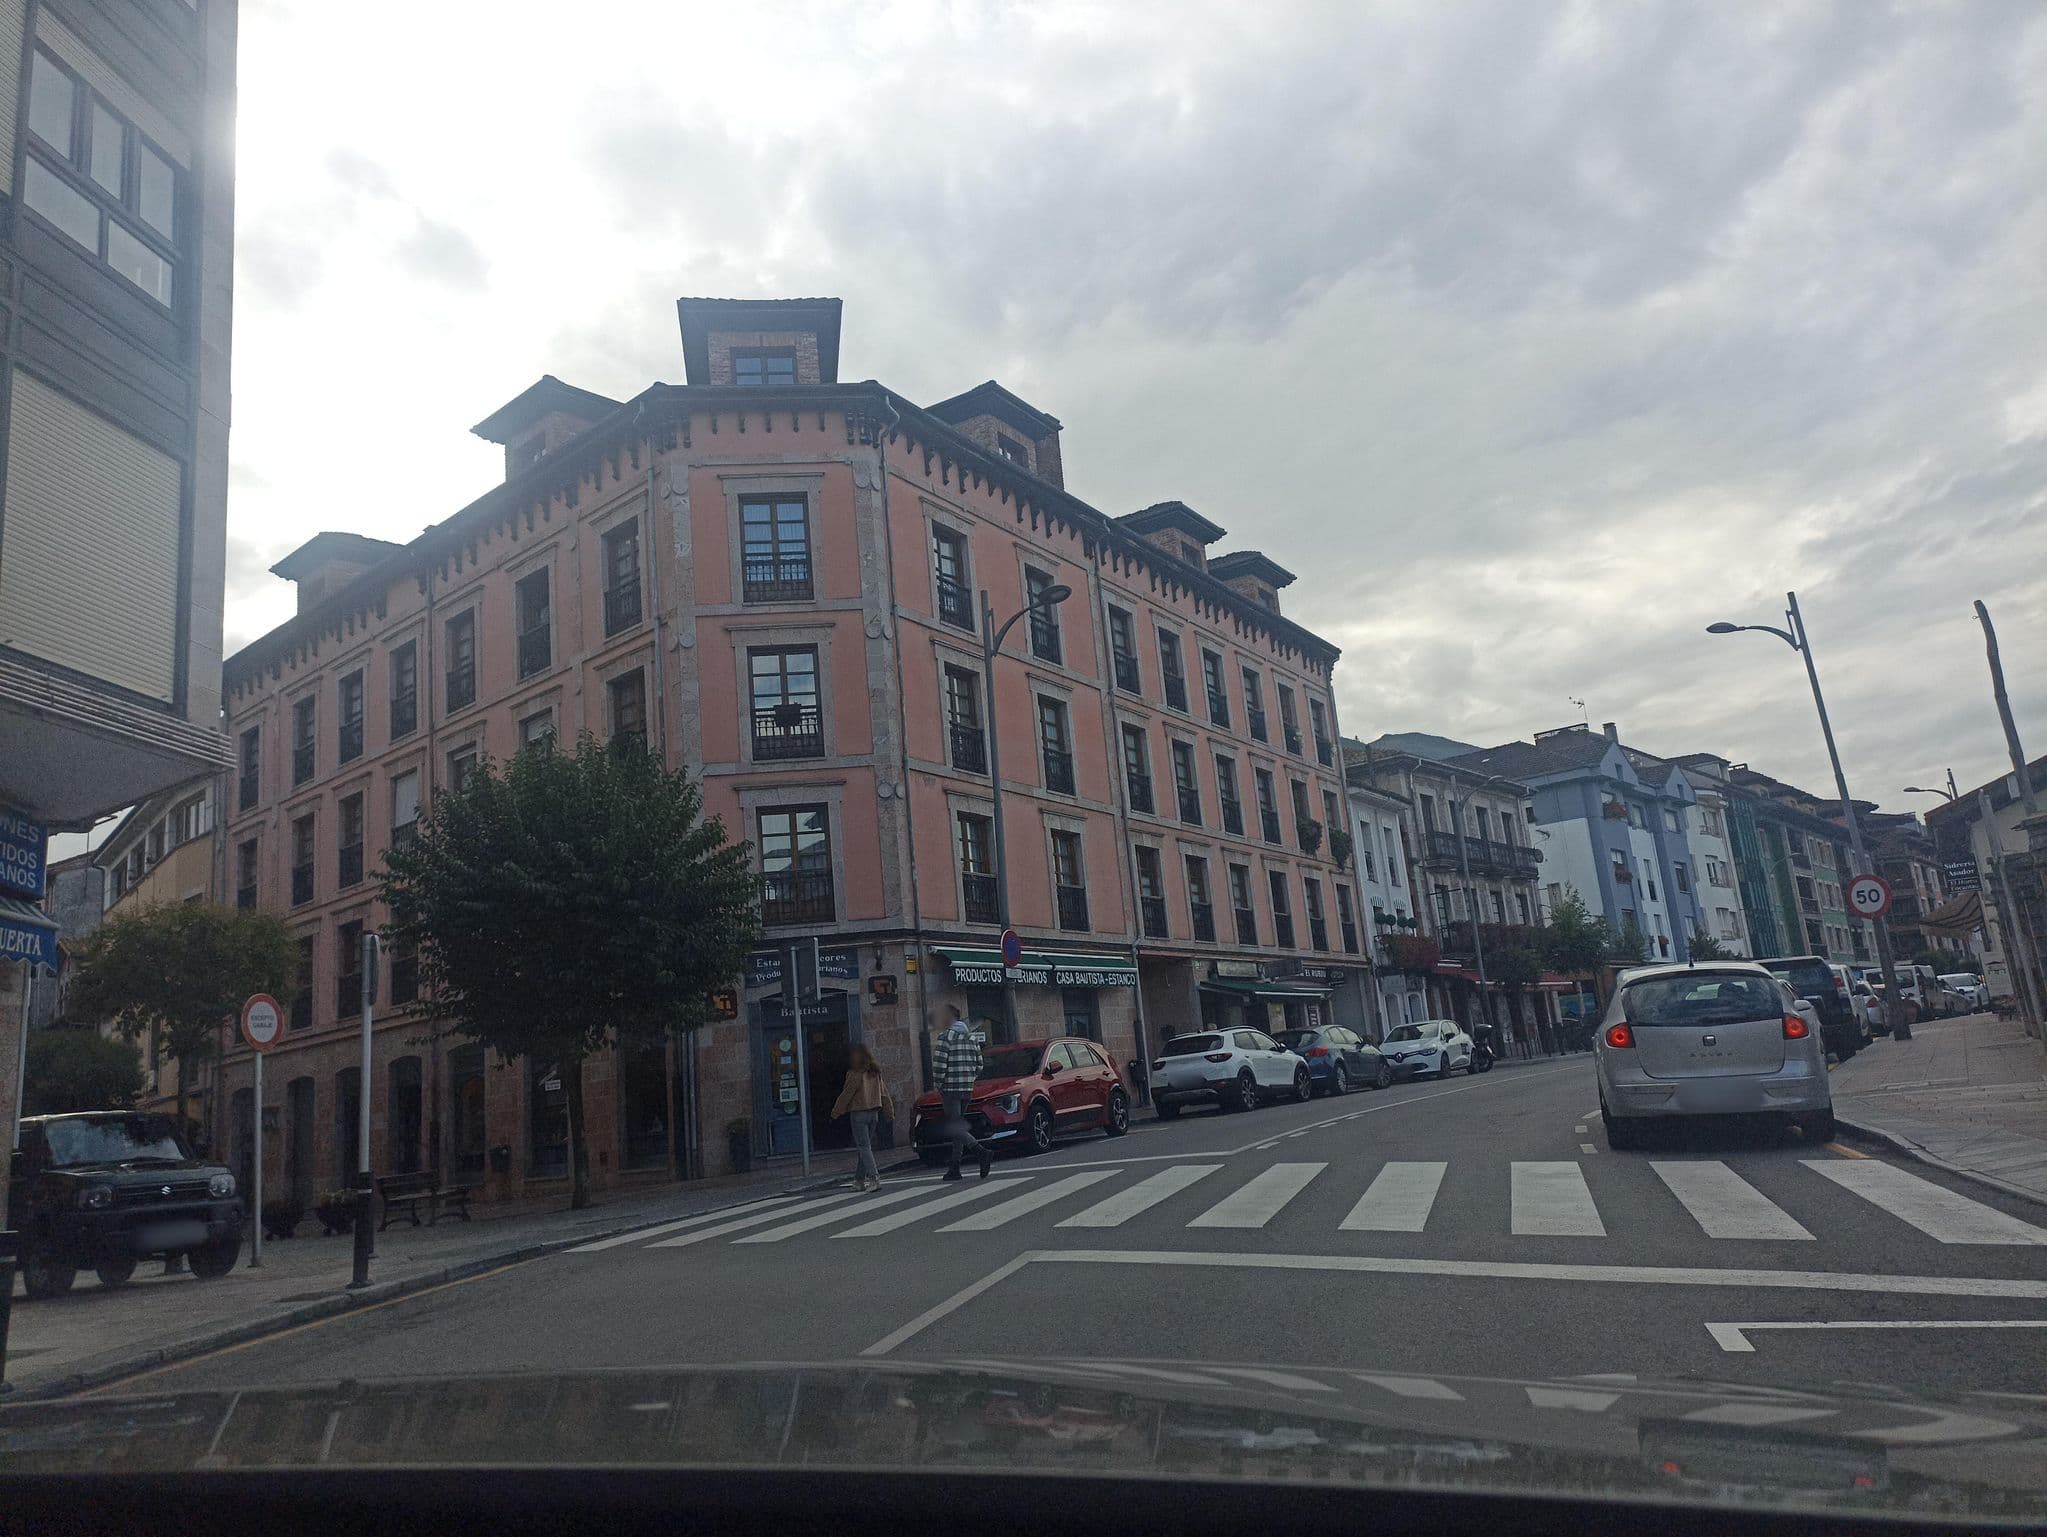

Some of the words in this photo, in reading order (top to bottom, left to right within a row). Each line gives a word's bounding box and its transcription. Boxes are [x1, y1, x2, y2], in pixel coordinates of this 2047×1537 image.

[0, 842, 37, 869] IDOS
[1857, 888, 1880, 904] 50
[819, 954, 847, 962] cores
[756, 970, 782, 983] Produ
[955, 968, 1002, 983] PRODUCTOS
[1056, 972, 1075, 985] CASA
[1076, 972, 1105, 985] BAUTISTA
